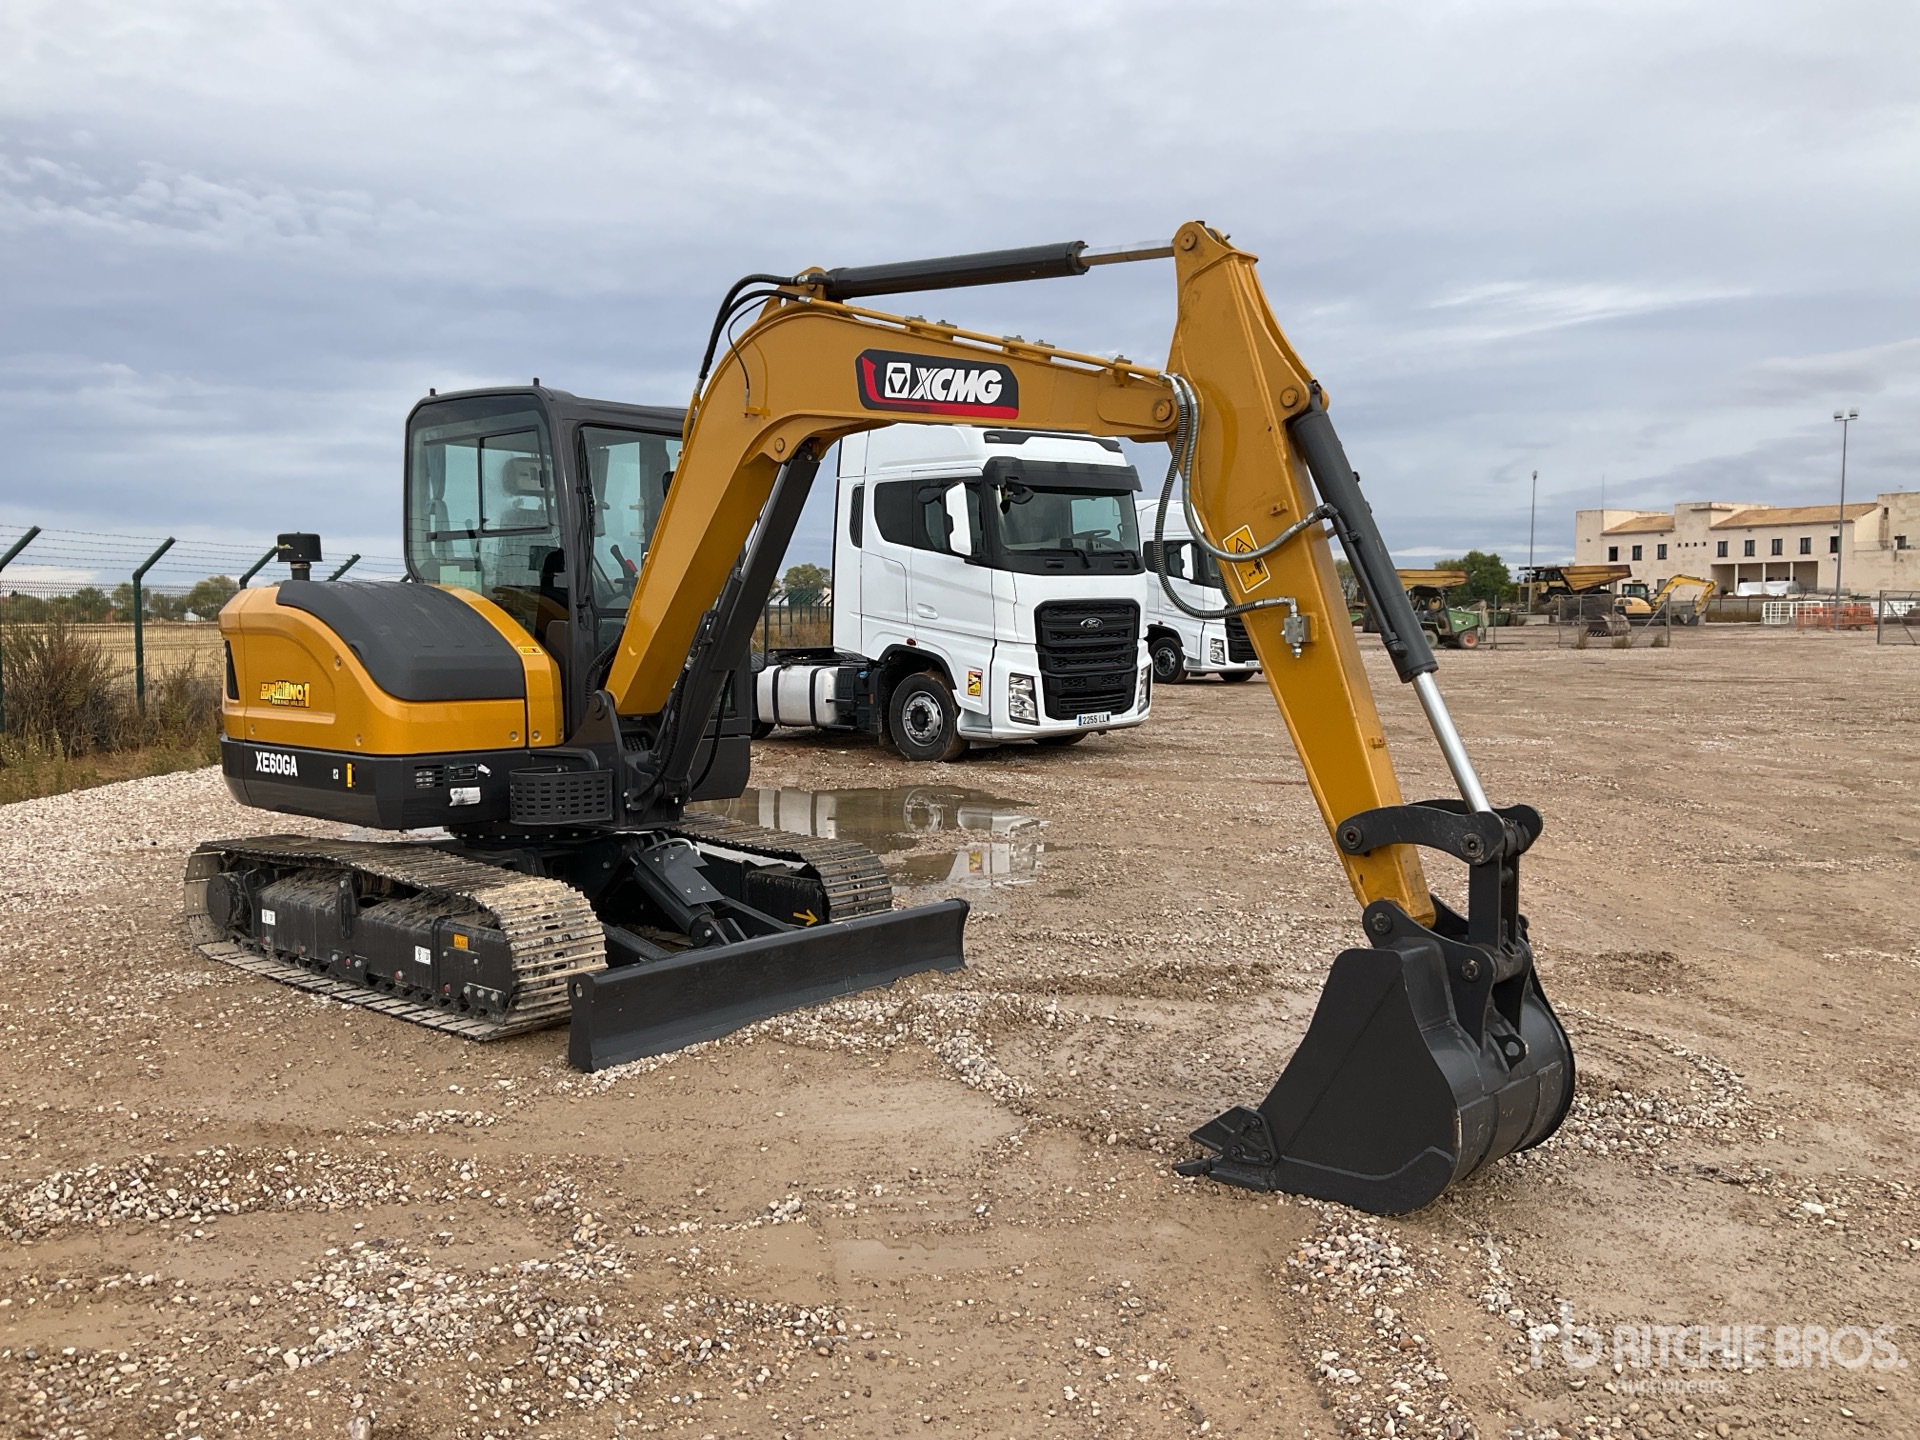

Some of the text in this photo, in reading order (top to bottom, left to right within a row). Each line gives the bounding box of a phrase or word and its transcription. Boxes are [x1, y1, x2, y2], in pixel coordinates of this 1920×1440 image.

[909, 367, 1003, 404] XCMG
[1082, 715, 1098, 725] 2255
[255, 751, 298, 777] XE60GA
